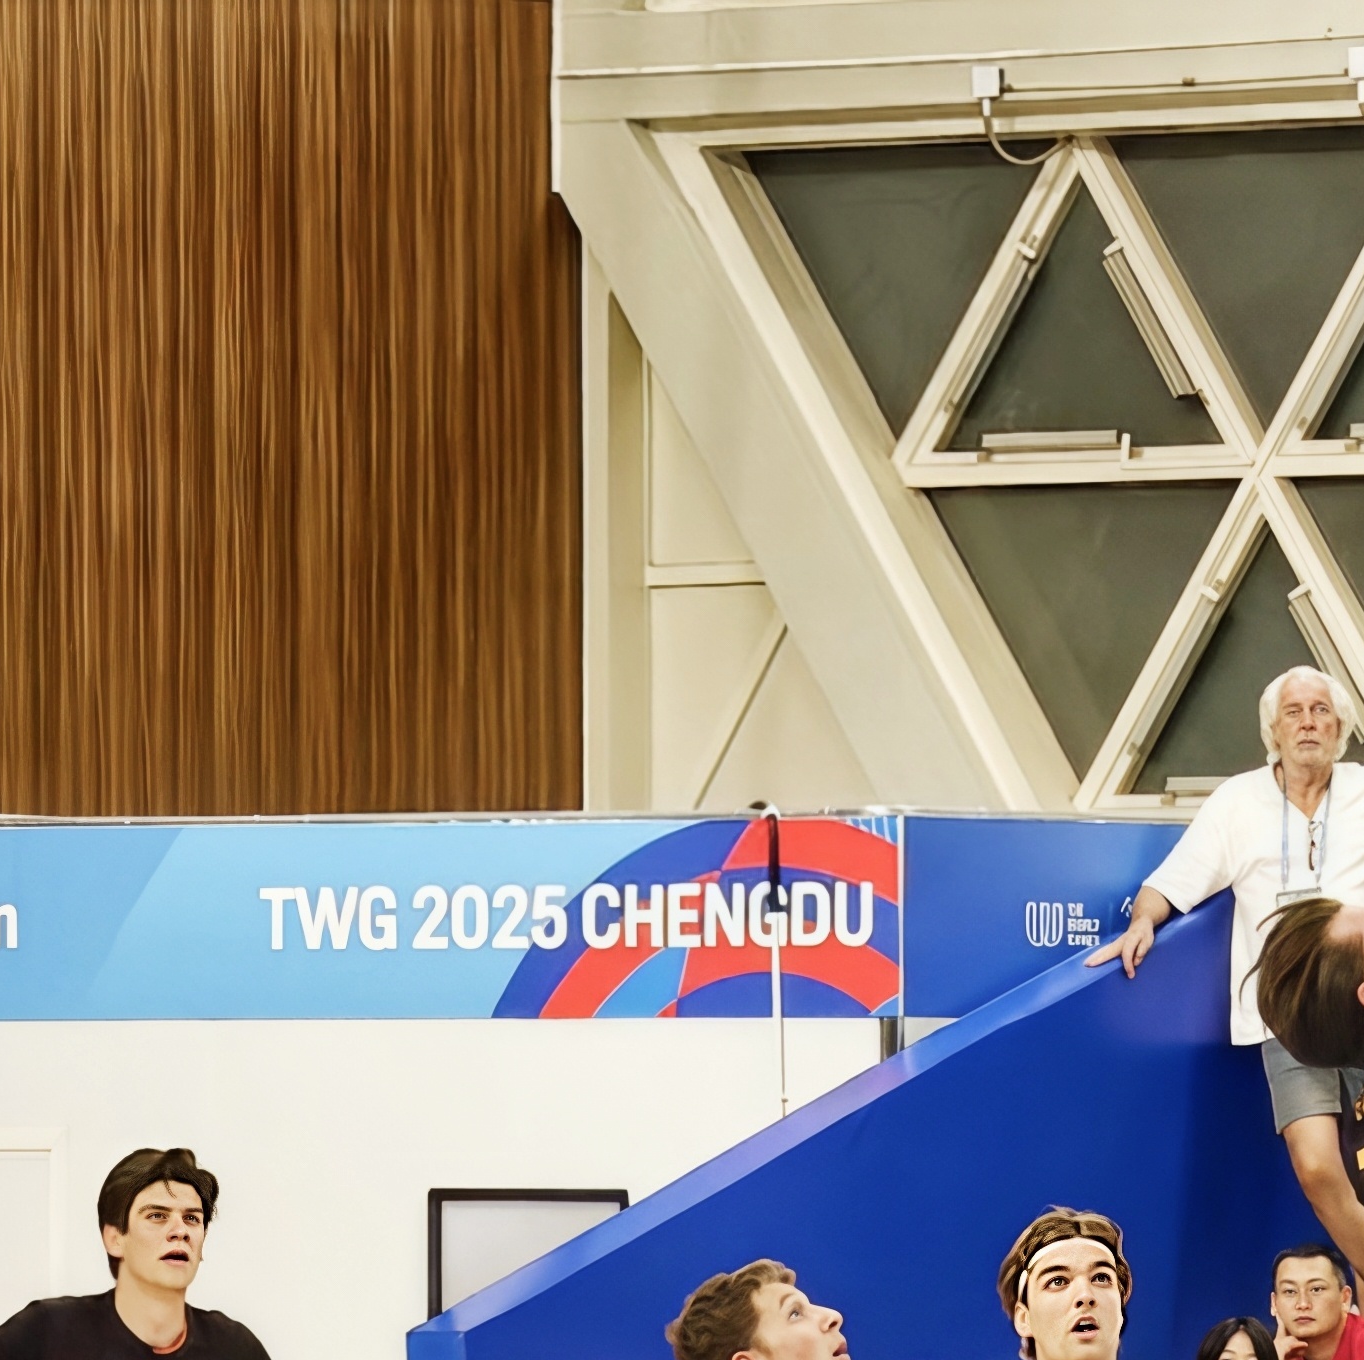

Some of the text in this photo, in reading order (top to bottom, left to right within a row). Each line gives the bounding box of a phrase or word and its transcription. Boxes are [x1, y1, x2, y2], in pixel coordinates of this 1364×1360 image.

[259, 880, 875, 951] TWG 2025 CHENGDU
